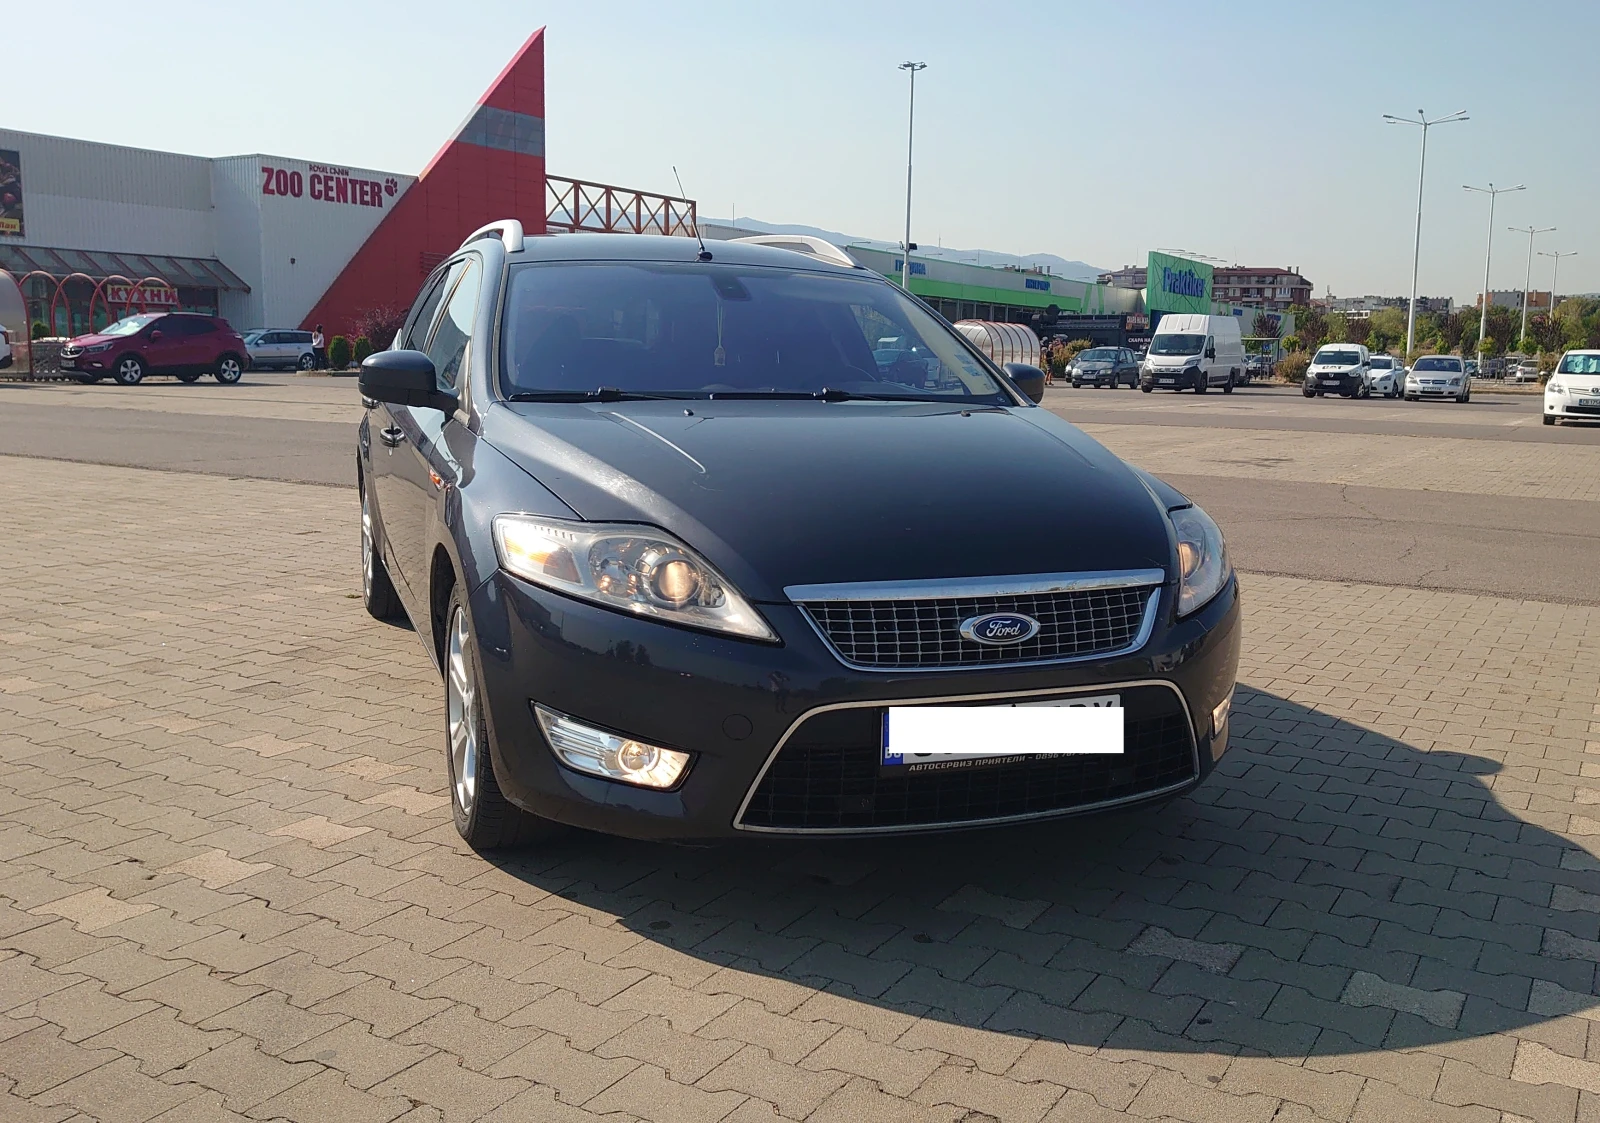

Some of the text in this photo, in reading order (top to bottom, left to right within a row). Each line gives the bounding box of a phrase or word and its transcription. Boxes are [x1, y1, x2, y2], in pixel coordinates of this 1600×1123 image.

[309, 164, 349, 176] ROYAL CANIN
[262, 166, 383, 208] ZOO CENTER
[1163, 267, 1205, 298] Praktiker
[111, 286, 178, 304] КУХНИ
[986, 619, 1021, 637] Ford
[908, 761, 972, 772] АВТОСЕРВИЗ
[975, 755, 1026, 767] ПРИЯТЕЛИ
[1035, 752, 1059, 760] 0896
